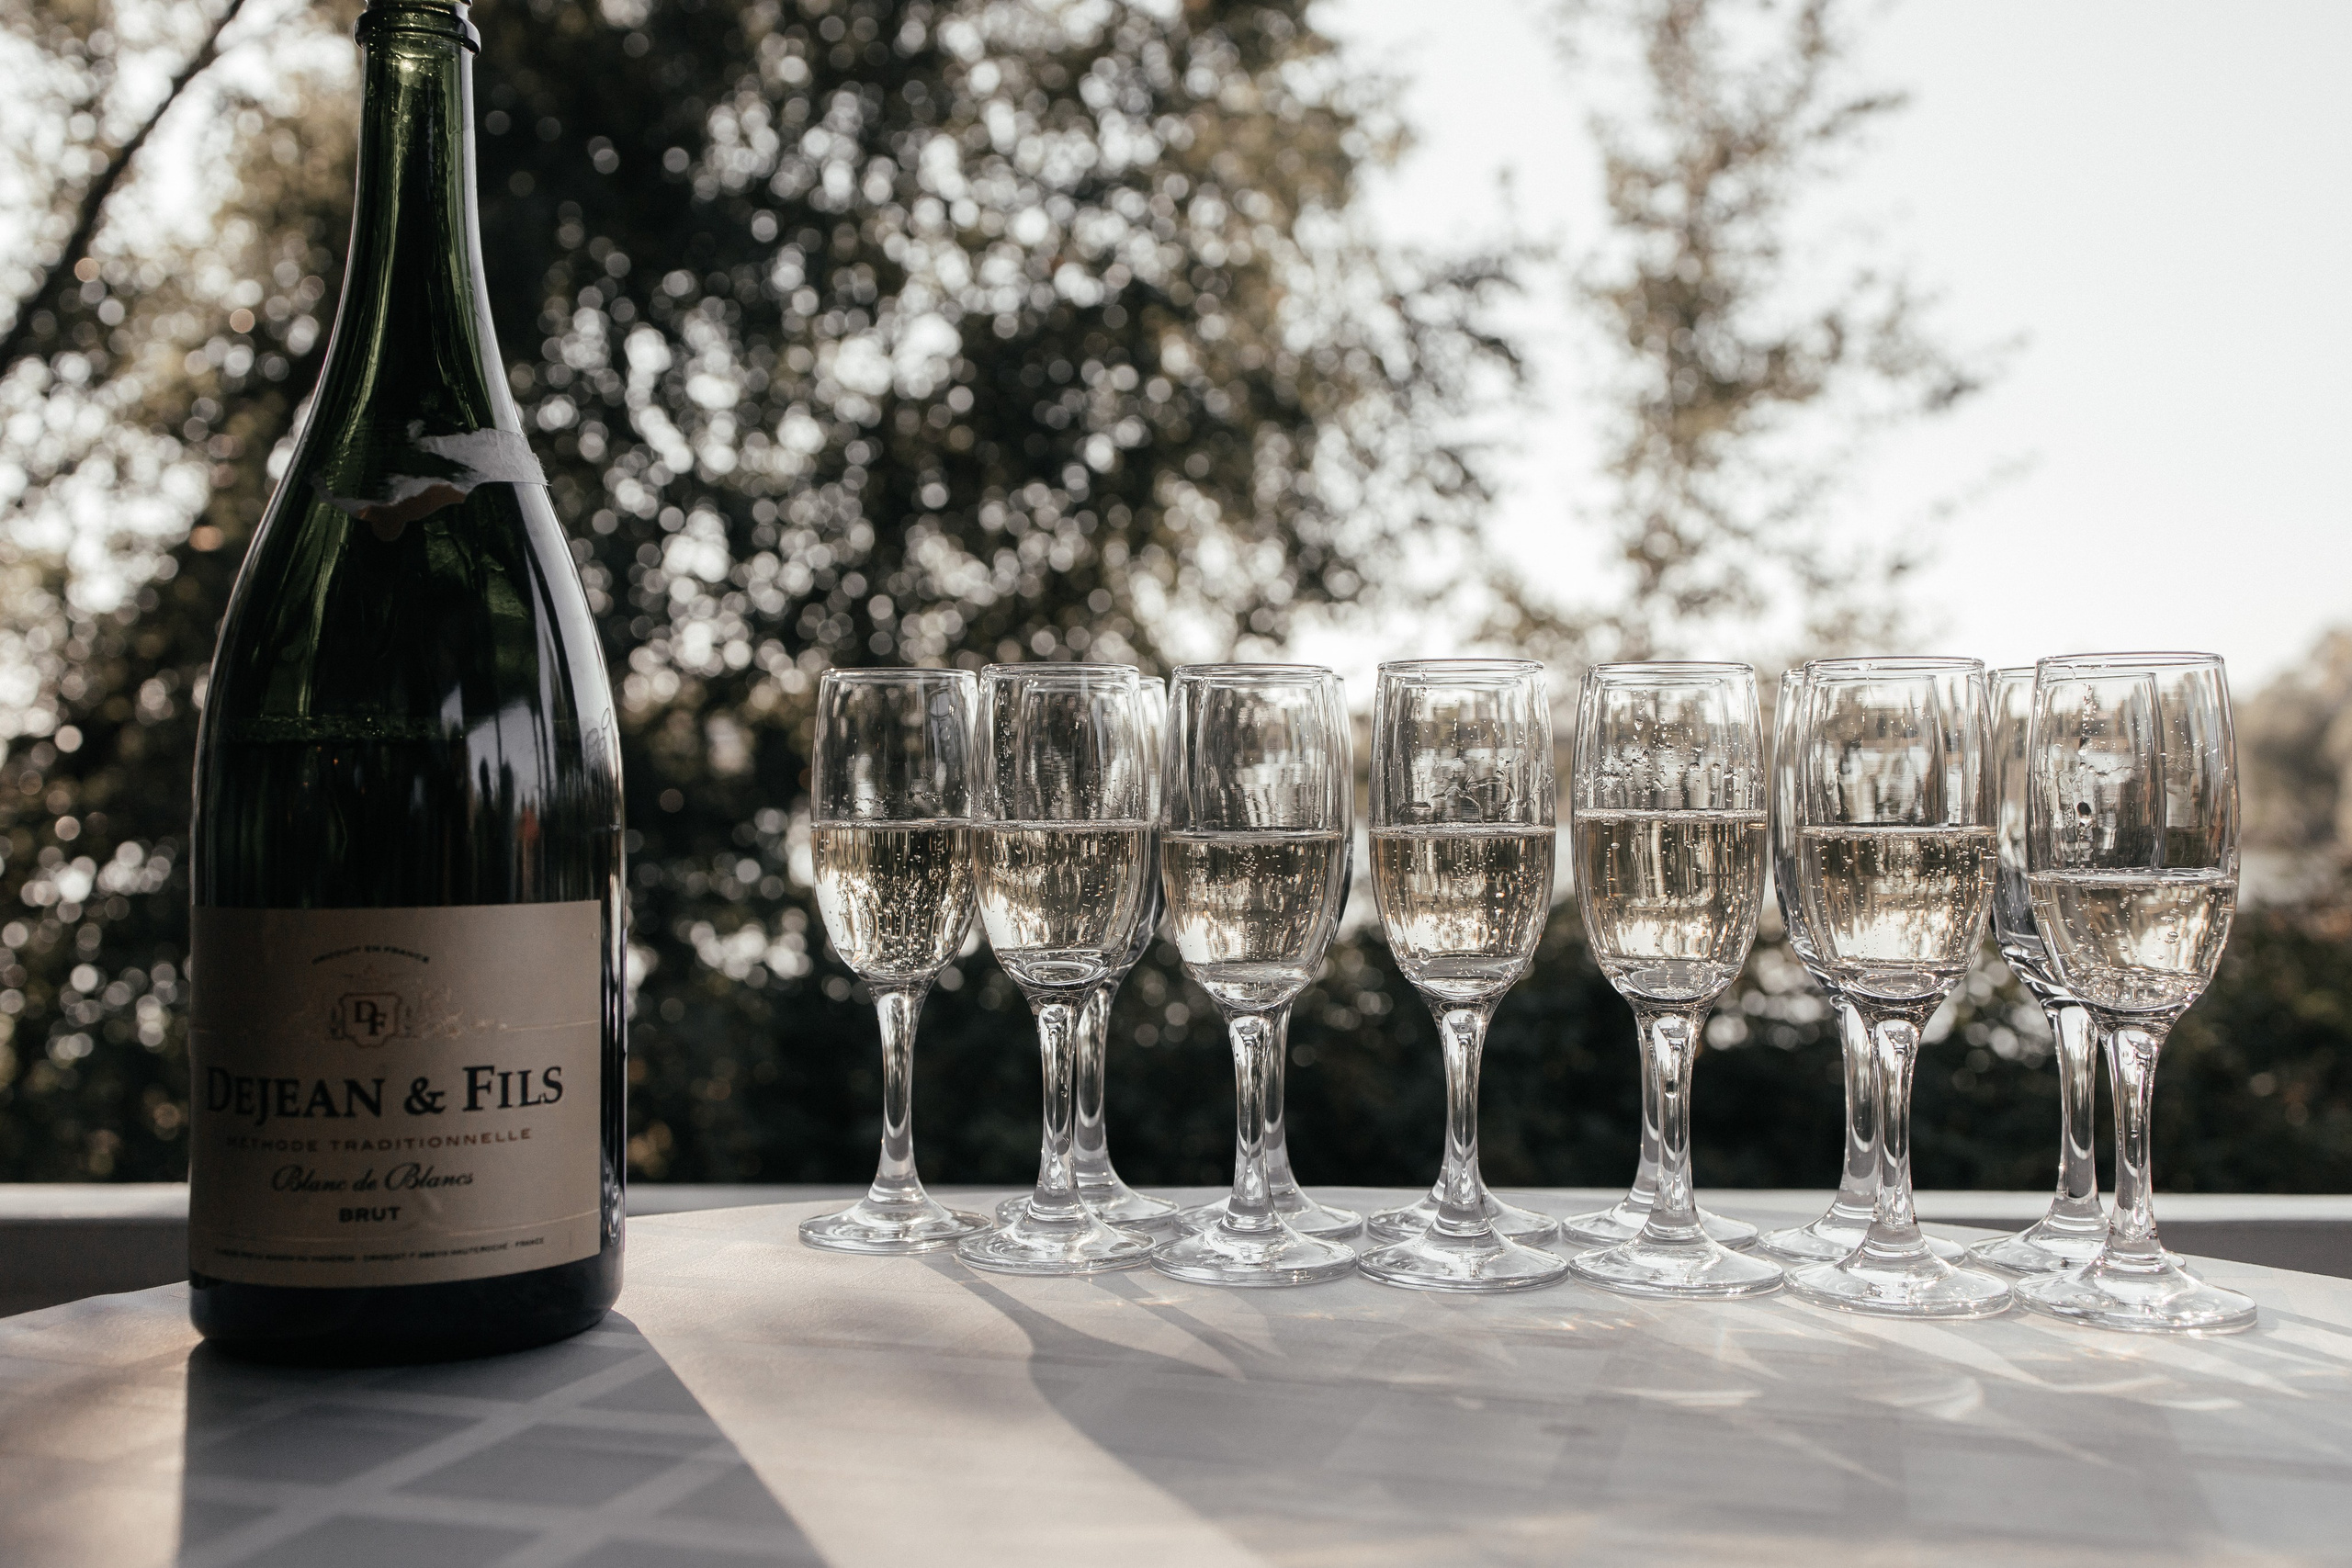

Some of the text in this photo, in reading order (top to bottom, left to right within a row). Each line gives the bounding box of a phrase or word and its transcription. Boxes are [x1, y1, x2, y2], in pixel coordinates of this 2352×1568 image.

[207, 1066, 386, 1126] DEJEAN
[404, 1077, 446, 1115] &
[330, 1128, 531, 1152] TRADITIONNELLE
[271, 1162, 473, 1192] Blanc de Blancs
[339, 1206, 401, 1223] BRUT
